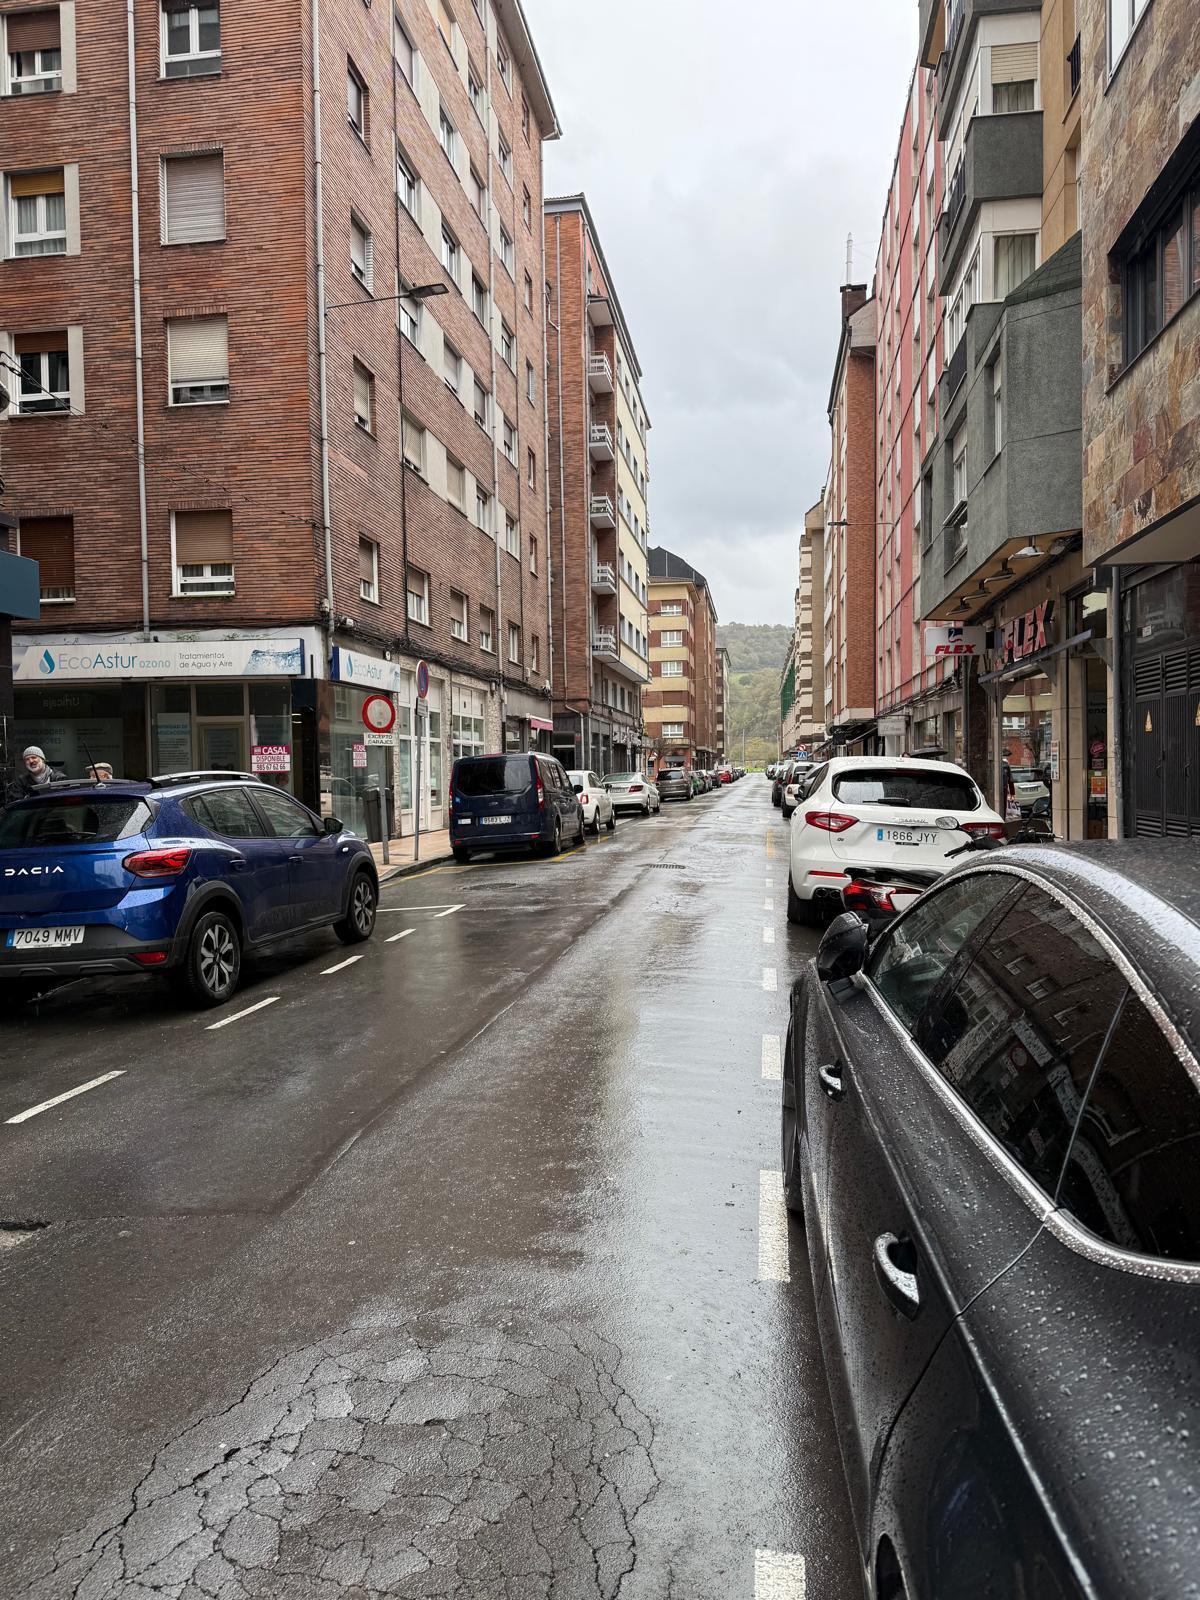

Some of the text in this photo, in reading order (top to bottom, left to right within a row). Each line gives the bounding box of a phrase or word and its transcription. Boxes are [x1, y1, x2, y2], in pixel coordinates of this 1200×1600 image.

[1002, 600, 1048, 664] FLEX
[935, 644, 976, 655] FLEX
[58, 652, 138, 670] EcoAstur
[179, 652, 225, 660] Tratamientos
[385, 651, 391, 661] 9
[191, 661, 211, 669] Agua
[353, 659, 382, 680] EcoAstur
[262, 746, 287, 755] CASAL
[887, 831, 937, 843] 1866 JYY
[4, 866, 64, 876] DACIA
[15, 927, 81, 945] 7049 MMV
